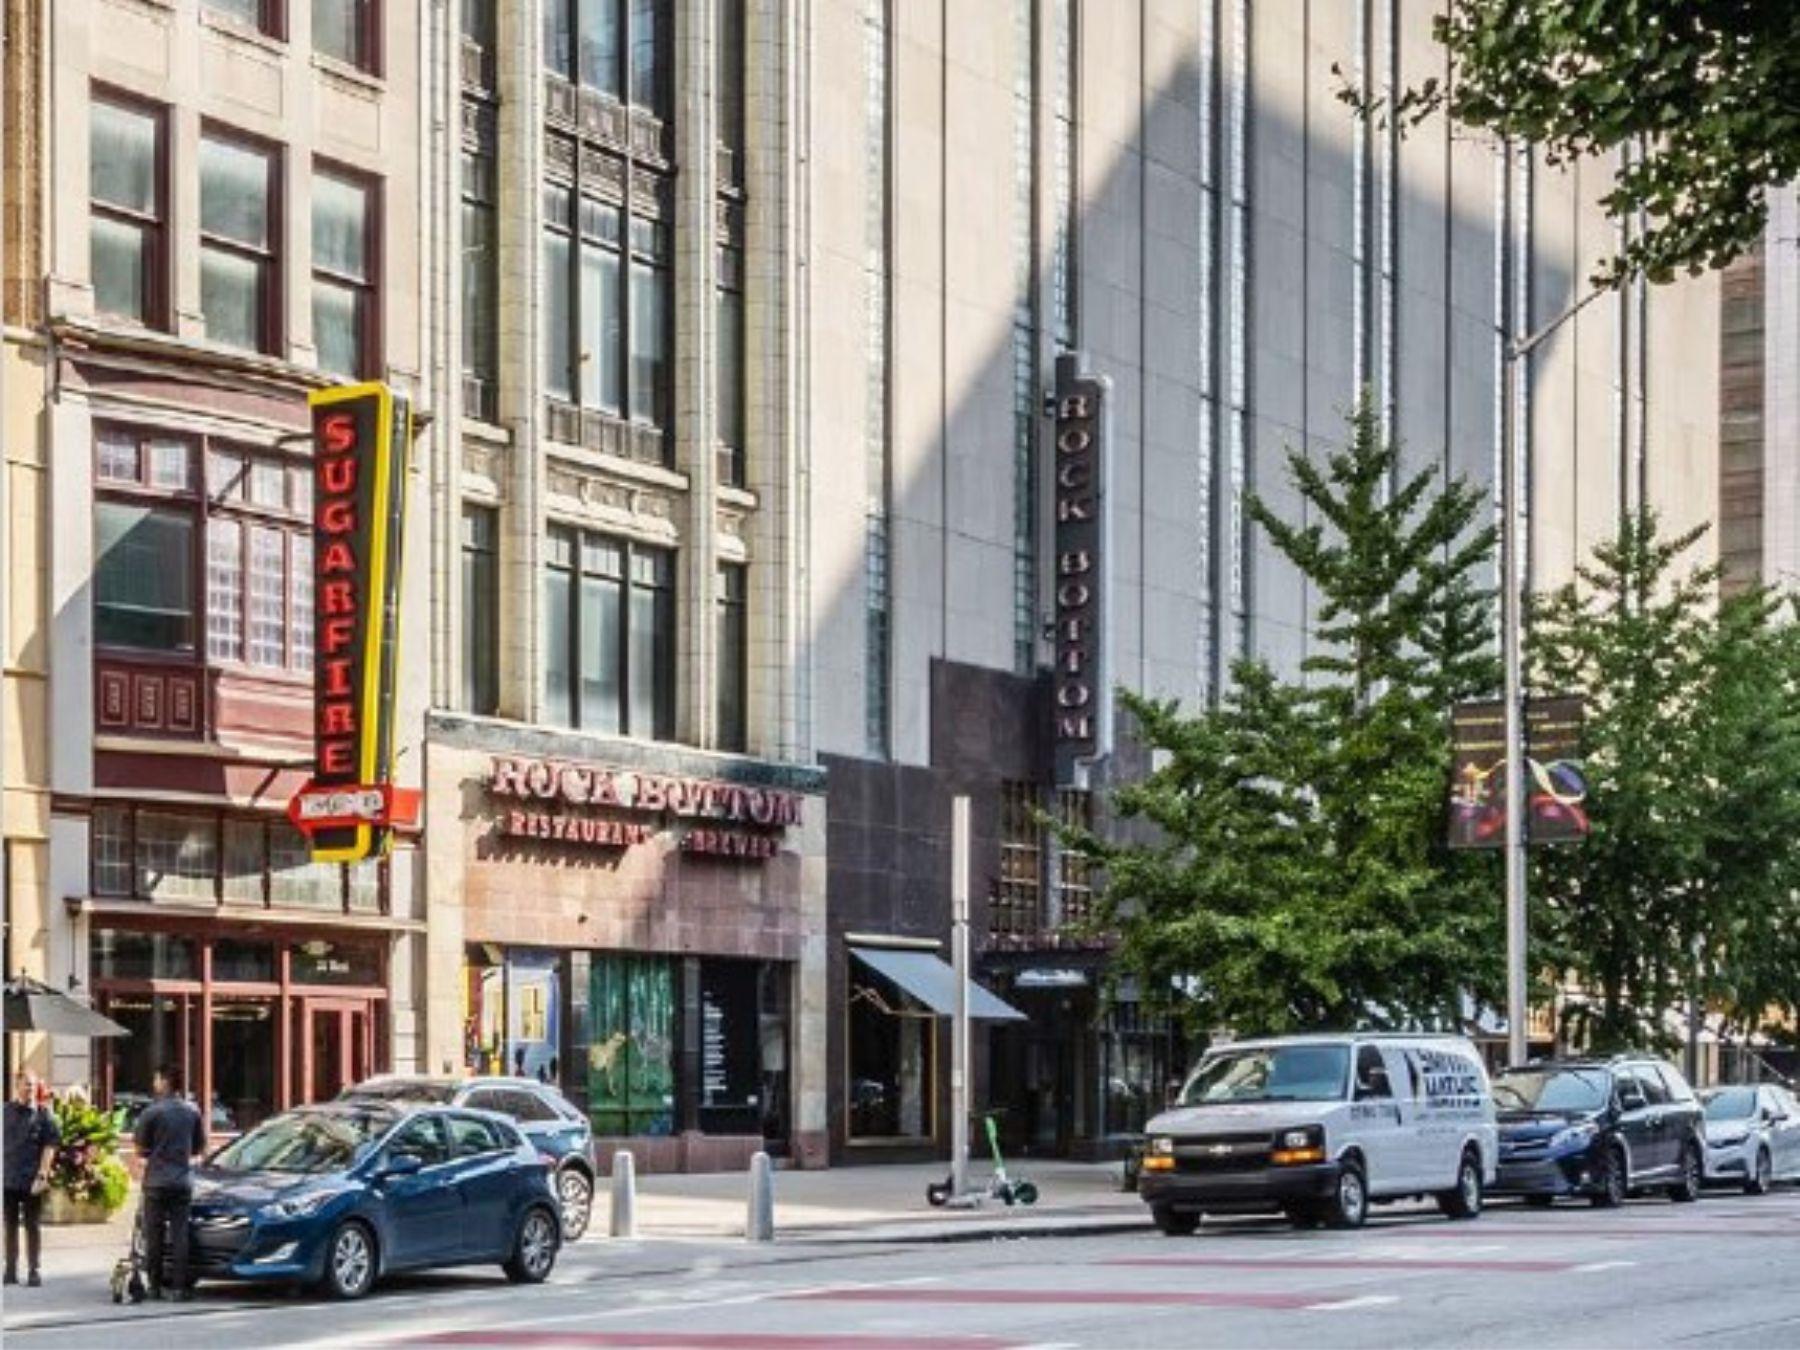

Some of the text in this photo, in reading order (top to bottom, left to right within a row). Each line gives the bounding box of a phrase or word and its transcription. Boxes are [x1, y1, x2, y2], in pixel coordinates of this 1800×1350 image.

[324, 414, 356, 773] SUGARFIRE
[1057, 395, 1090, 738] ROCK BOTTOM
[489, 757, 804, 826] ROCK BOTTOM
